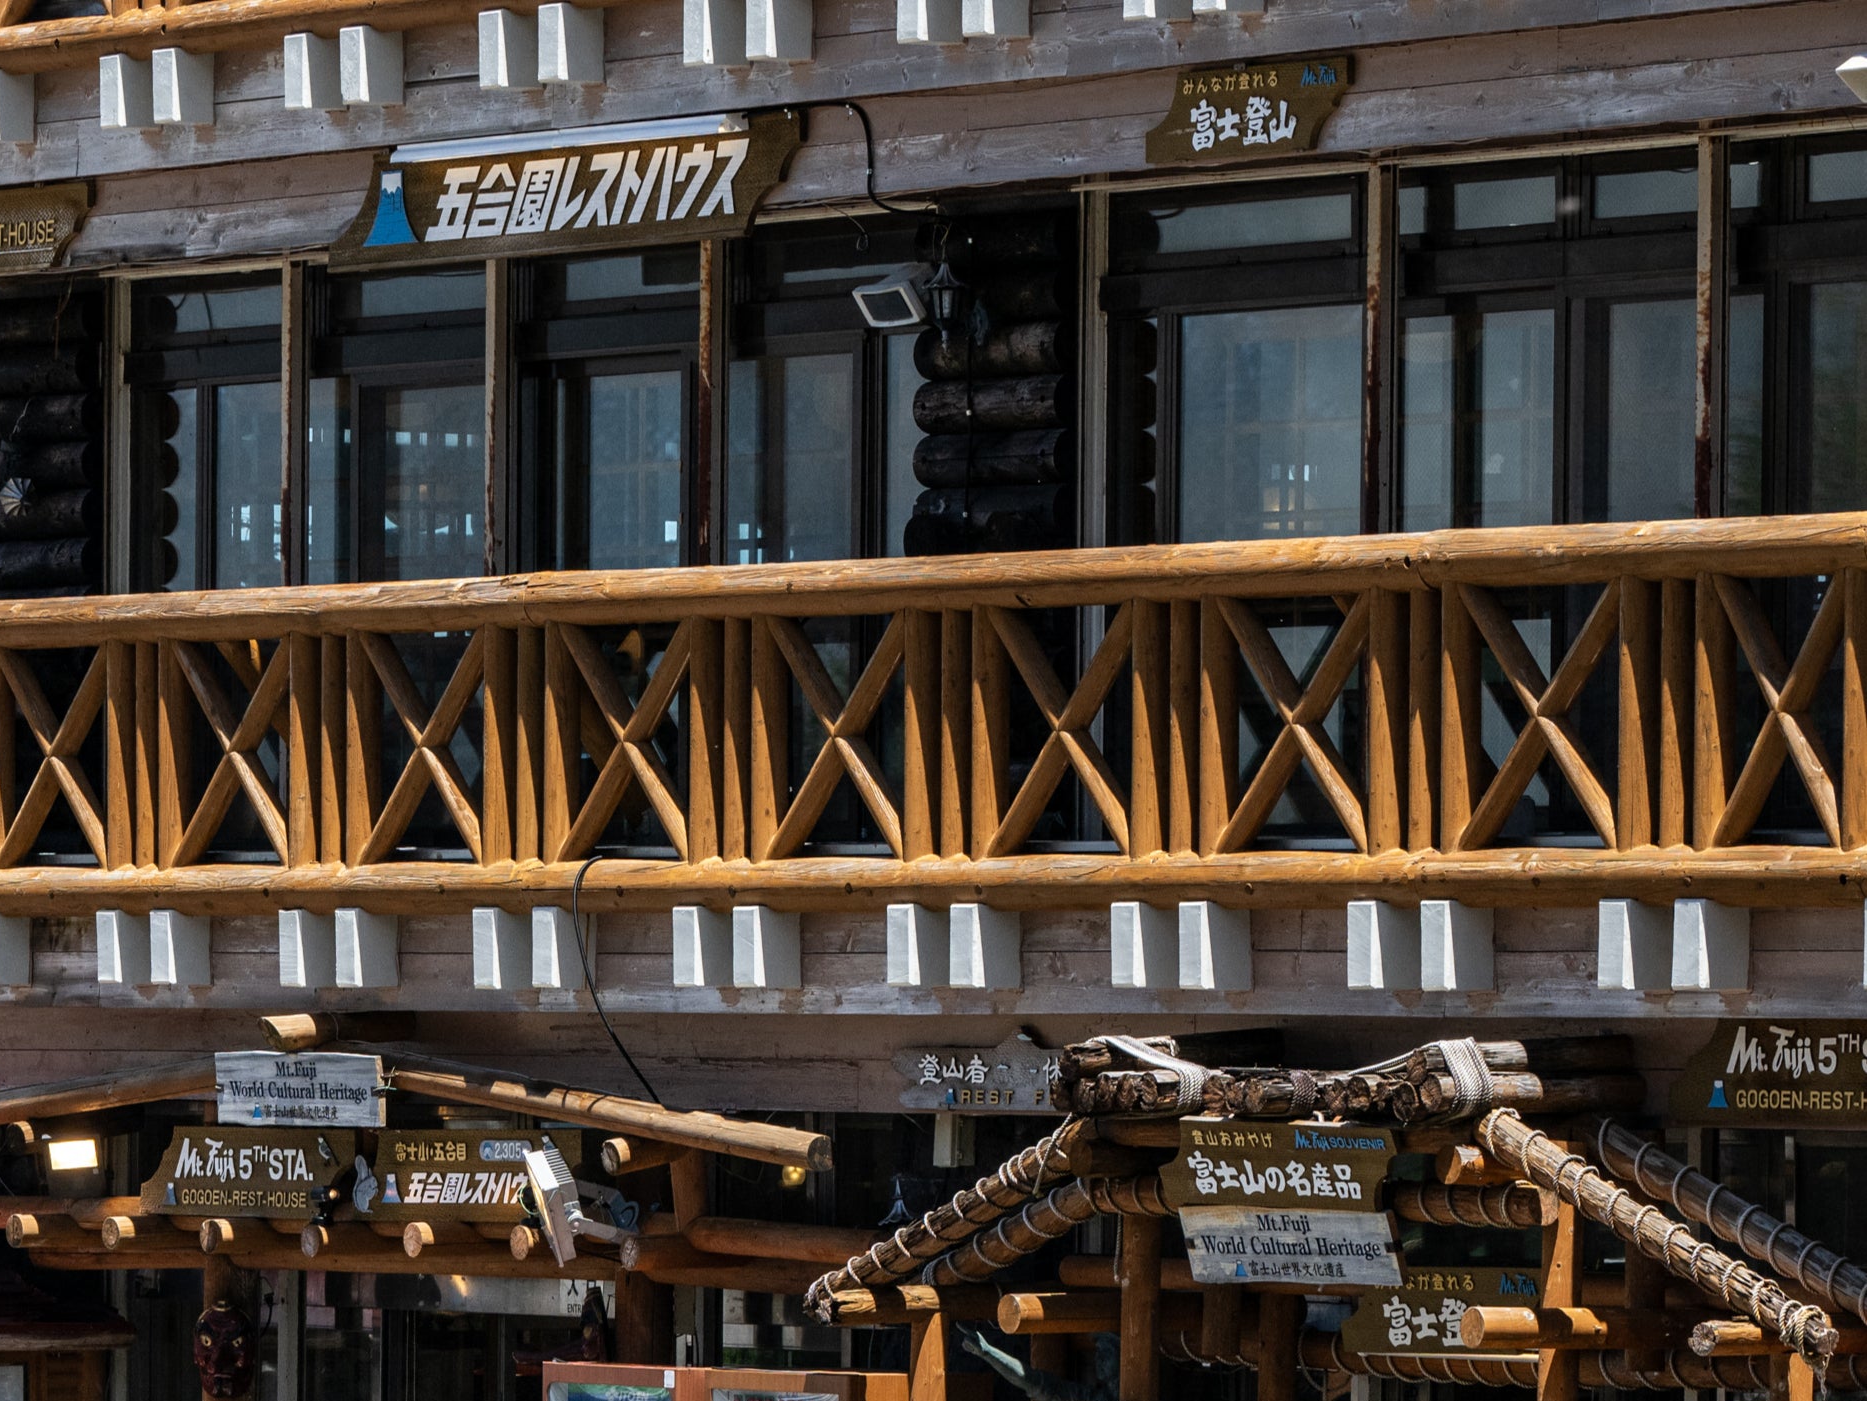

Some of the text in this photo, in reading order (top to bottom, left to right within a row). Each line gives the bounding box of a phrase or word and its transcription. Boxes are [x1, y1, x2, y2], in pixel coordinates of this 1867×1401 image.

[1182, 71, 1278, 95] みんなが登れる
[1190, 96, 1297, 152] 富士登山
[424, 137, 750, 243] 五合園レストハウス
[1726, 1026, 1768, 1074] Mt.
[1769, 1025, 1815, 1079] Fuji
[275, 1061, 317, 1080] Mt.Fuji
[919, 1053, 990, 1086] 登山者
[230, 1081, 367, 1105] World Cultural Heritage
[961, 1089, 1015, 1105] REST
[1192, 1130, 1272, 1148] 登山おみやげ
[1330, 1138, 1386, 1150] SOUVENIR
[174, 1137, 204, 1179] Mt.
[205, 1137, 235, 1183] Fuji
[269, 1148, 314, 1181] STA.
[1187, 1150, 1362, 1200] 富士山の名産品
[182, 1188, 307, 1208] GOGOEN-REST-HOUSE
[1256, 1215, 1311, 1235] Mt.Fuji
[1201, 1235, 1381, 1261] World Cultural Heritage
[1248, 1262, 1346, 1278] 富士山世界文化遺産
